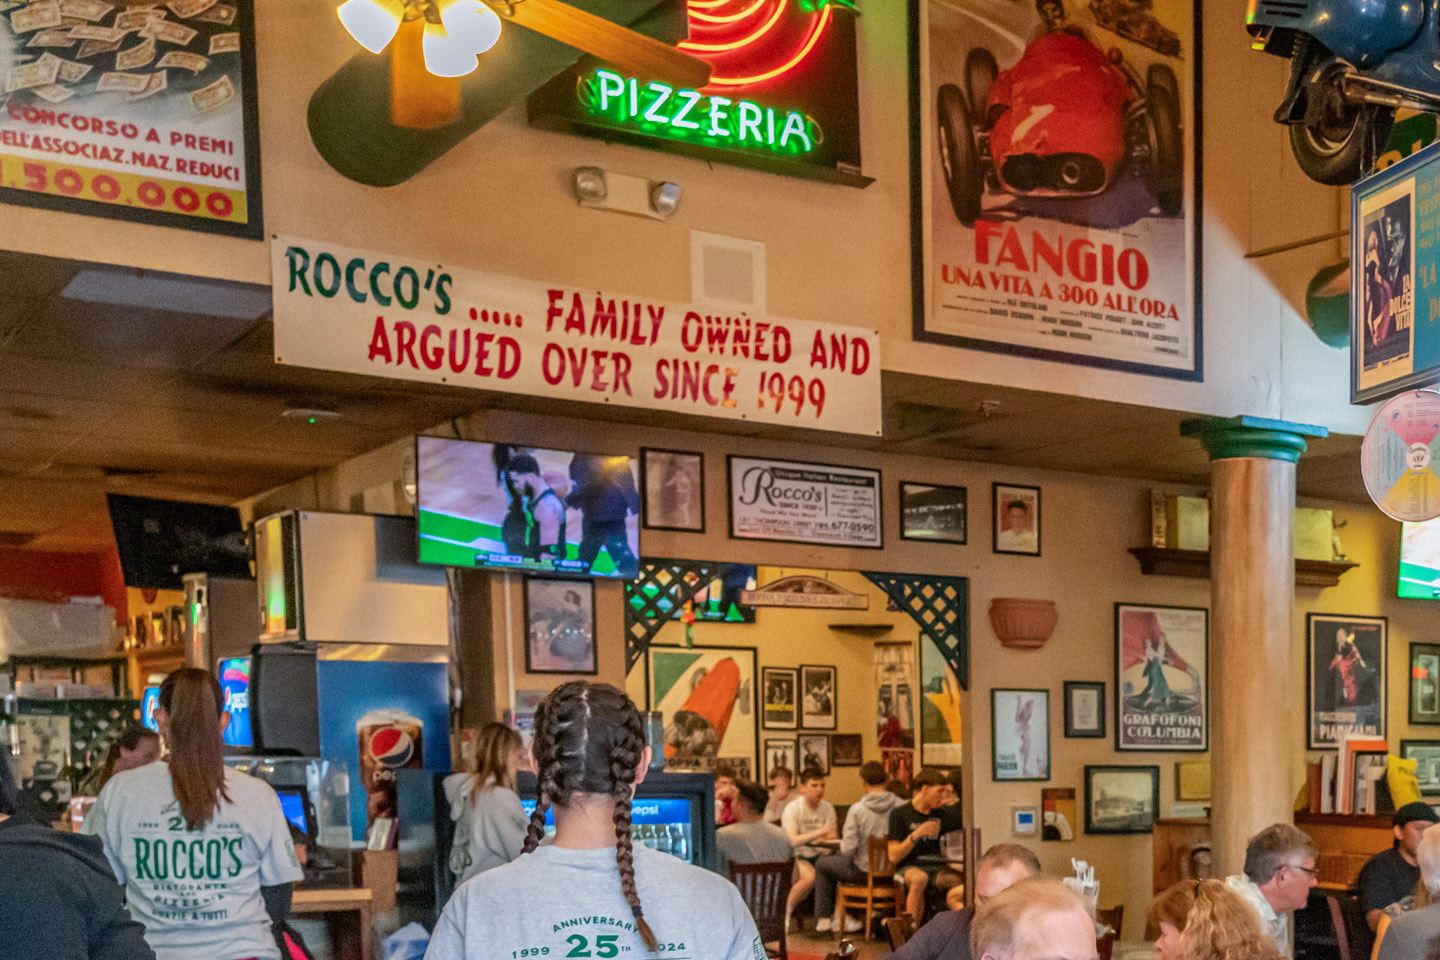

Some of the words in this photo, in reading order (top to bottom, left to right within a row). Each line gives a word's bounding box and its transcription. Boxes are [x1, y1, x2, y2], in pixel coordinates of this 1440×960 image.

[8, 103, 138, 139] CONCORSO
[145, 128, 161, 143] A
[170, 131, 234, 155] PREMI
[596, 69, 812, 151] PIZZERIA
[0, 130, 129, 164] ELL'ASSOCIAZ.
[176, 158, 239, 182] REDUCI
[974, 219, 1149, 290] FANGIO
[285, 246, 452, 315] ROCCO'S
[546, 289, 664, 346] FAMILY
[681, 311, 791, 364] OWNED
[811, 329, 870, 375] AND
[942, 264, 986, 290] UNA
[989, 272, 1034, 299] VITA
[1040, 281, 1053, 300] A
[1058, 283, 1099, 307] 300
[1103, 291, 1180, 321] ALL'ORA
[368, 316, 521, 380] ARGUED
[542, 342, 632, 397] OVER
[654, 358, 740, 409] SINCE
[758, 371, 825, 419] 1999
[1126, 725, 1201, 739] COLUMBIA
[132, 836, 244, 880] ROCCO'S
[512, 946, 550, 959] 1999
[566, 933, 619, 958] 25
[647, 942, 687, 952] 024
[553, 916, 639, 933] ANNIVERSARY
